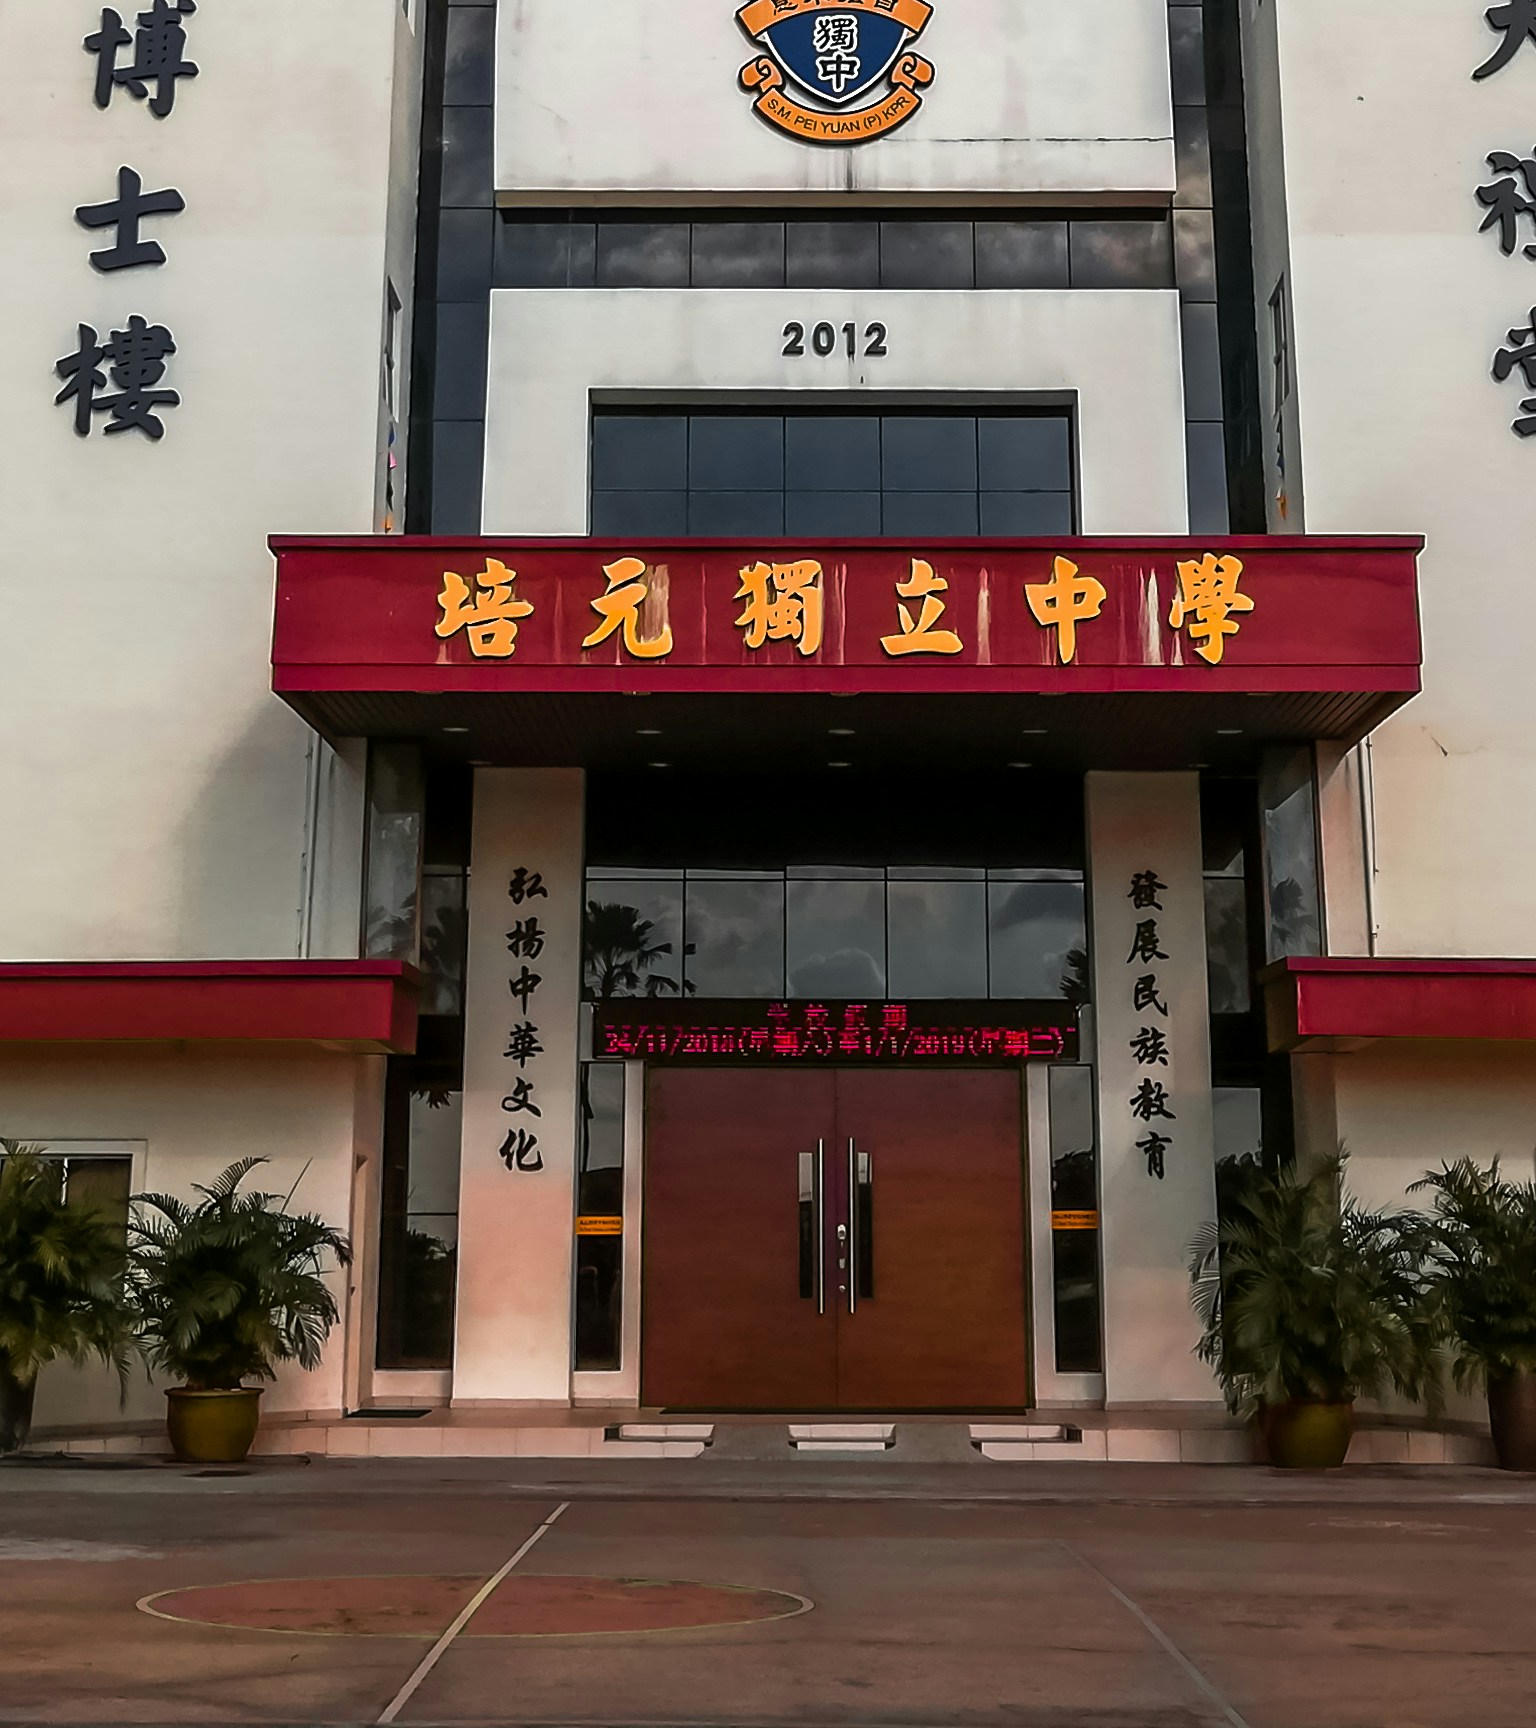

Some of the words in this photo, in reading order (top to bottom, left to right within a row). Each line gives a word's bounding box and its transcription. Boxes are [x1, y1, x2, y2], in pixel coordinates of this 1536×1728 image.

[814, 16, 859, 92] 獨中
[767, 97, 792, 123] S.M.
[794, 115, 818, 132] PEI
[820, 120, 862, 134] YUAN
[863, 114, 883, 129] (P)
[883, 95, 911, 121] KPR
[781, 321, 887, 356] 2012
[434, 553, 1255, 665] 培元獨立中學
[499, 866, 549, 1172] 弘揚中華文化
[1126, 868, 1177, 1180] 發展民族教育
